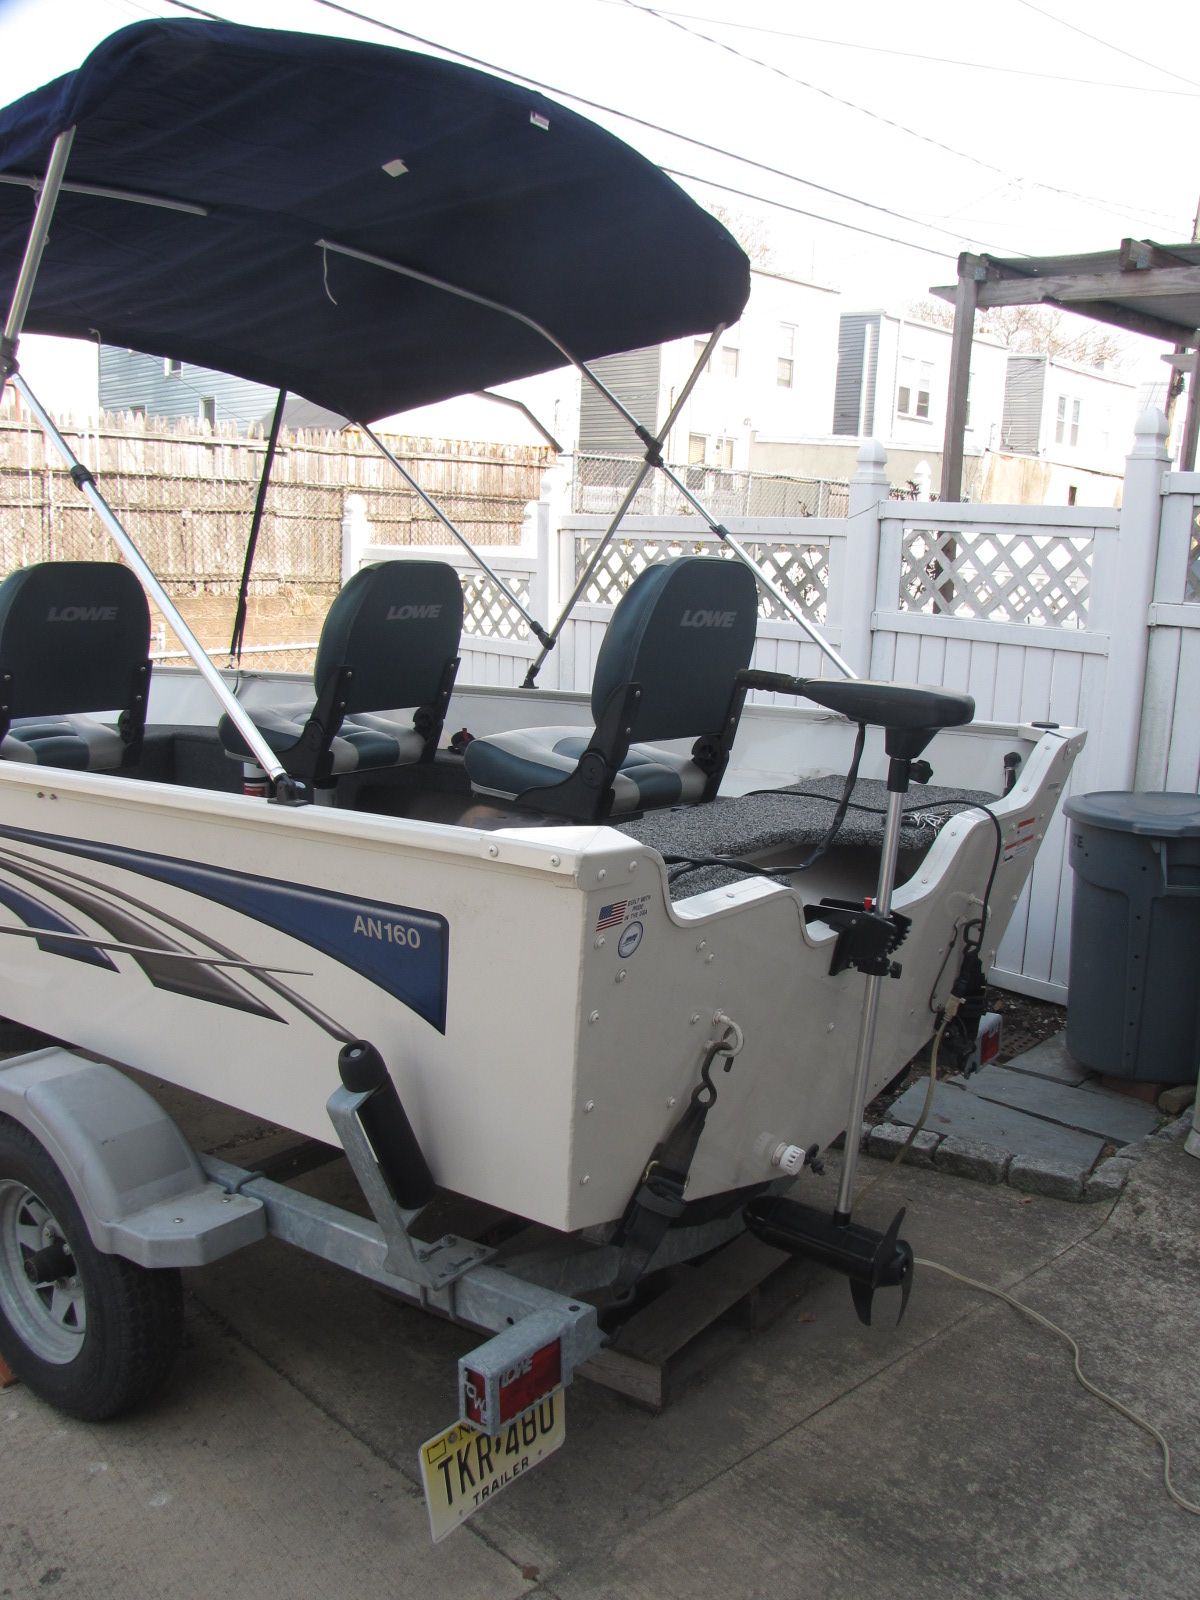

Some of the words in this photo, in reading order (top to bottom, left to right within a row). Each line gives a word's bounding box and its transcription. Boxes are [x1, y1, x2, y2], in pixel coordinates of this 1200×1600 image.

[46, 606, 119, 622] LOWE
[385, 605, 443, 620] LOWE
[679, 609, 738, 628] LOWE
[353, 914, 421, 949] AN160
[473, 1456, 530, 1506] TRAILER
